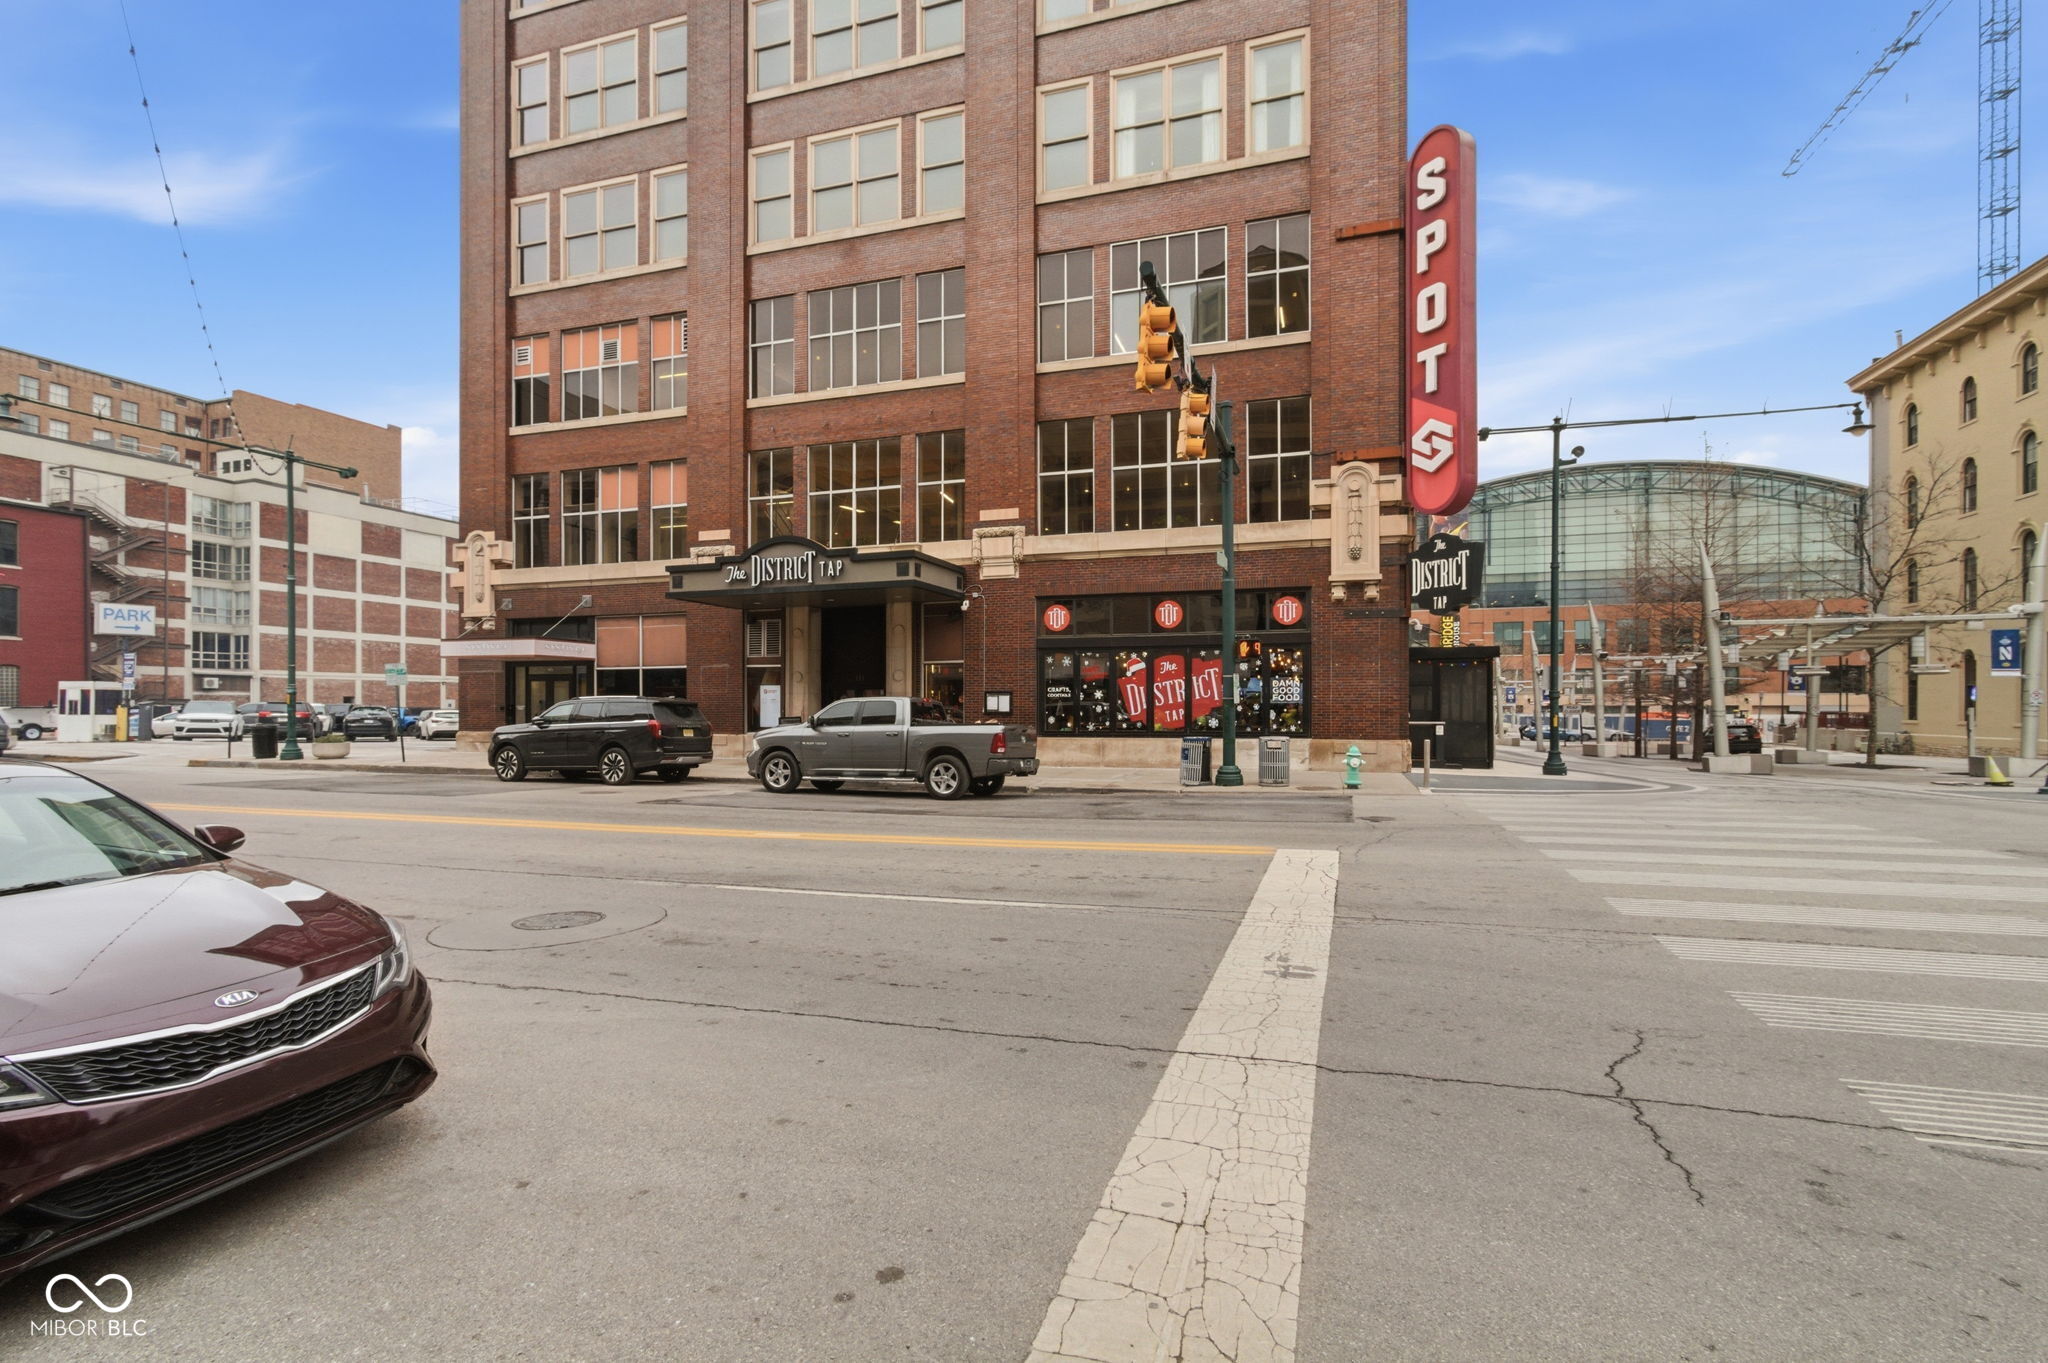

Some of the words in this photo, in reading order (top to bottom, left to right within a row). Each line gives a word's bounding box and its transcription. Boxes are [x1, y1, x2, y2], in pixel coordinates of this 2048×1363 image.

[1416, 156, 1447, 394] SPOT
[1433, 540, 1446, 552] The
[725, 566, 746, 583] The
[751, 551, 816, 587] DISTRICT
[819, 560, 843, 577] TAP
[1411, 549, 1470, 597] DISTRICT
[1433, 596, 1447, 610] TAP
[103, 607, 152, 622] PARK
[1160, 661, 1178, 674] The
[1272, 679, 1300, 688] DAMN
[1272, 694, 1300, 702] FOOD
[1165, 709, 1185, 722] TAP
[221, 991, 254, 1005] KIA
